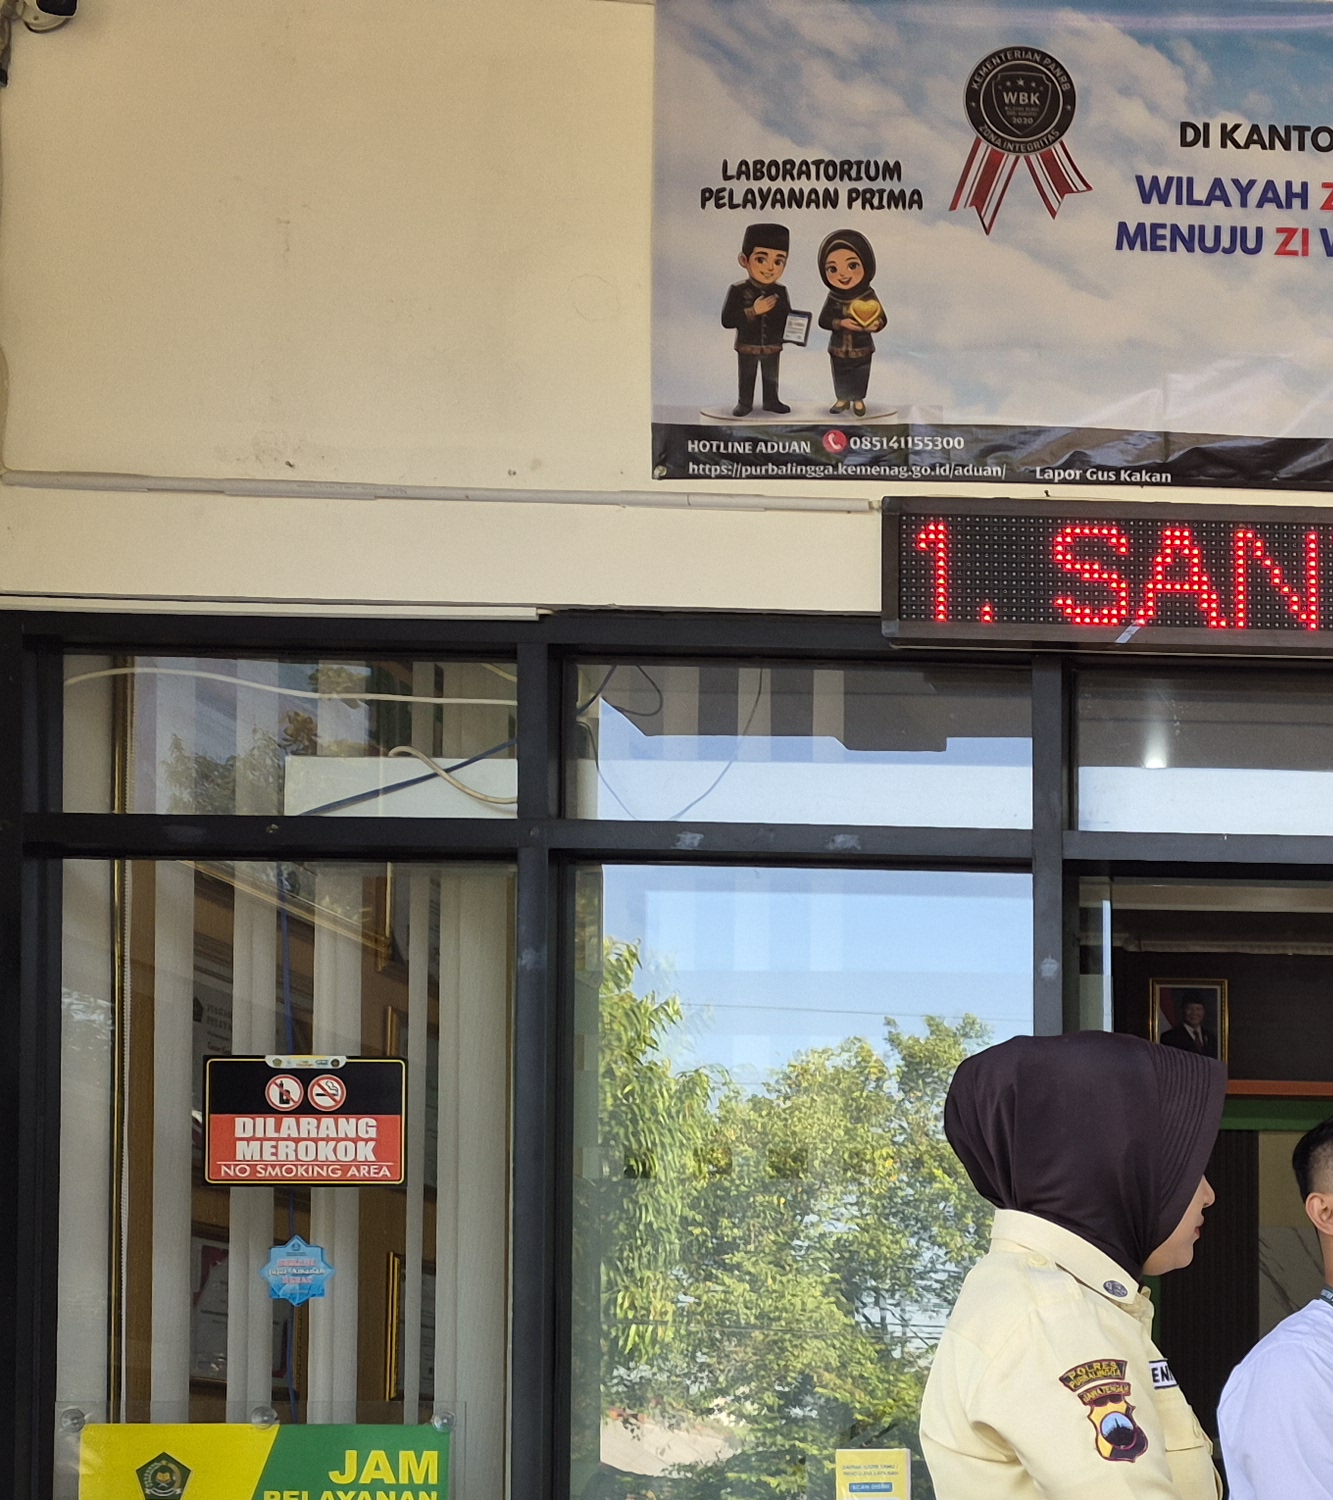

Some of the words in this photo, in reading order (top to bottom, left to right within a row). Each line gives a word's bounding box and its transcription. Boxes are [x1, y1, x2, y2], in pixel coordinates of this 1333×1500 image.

[1043, 57, 1071, 92] PANRB
[1002, 91, 1041, 105] WBK
[1012, 116, 1034, 124] 2020
[978, 125, 1001, 146] ZONA
[1179, 121, 1211, 149] DI
[721, 158, 902, 182] LABORATORIUM
[700, 186, 840, 211] PELAYANAN
[847, 187, 924, 211] PRIMA
[1134, 174, 1309, 211] WILAYAH
[1115, 221, 1264, 256] MENUJU
[1274, 227, 1309, 257] ZI
[687, 438, 753, 455] HOTLINE
[756, 439, 811, 454] ADUAN
[849, 435, 965, 451] 085141155300
[688, 461, 1006, 481] https://purbalingga.kemenag.go.id/aduan/
[1035, 465, 1082, 485] Lapor
[1085, 466, 1116, 483] Gus
[1119, 468, 1172, 484] Kakan
[914, 518, 998, 625] 1.
[234, 1117, 378, 1139] DILARANG
[235, 1140, 377, 1162] MEROKOK
[221, 1163, 250, 1178] NO
[256, 1163, 342, 1178] SMOKING
[346, 1164, 391, 1178] AREA
[1068, 1361, 1118, 1380] POLRES
[327, 1449, 440, 1486] JAM
